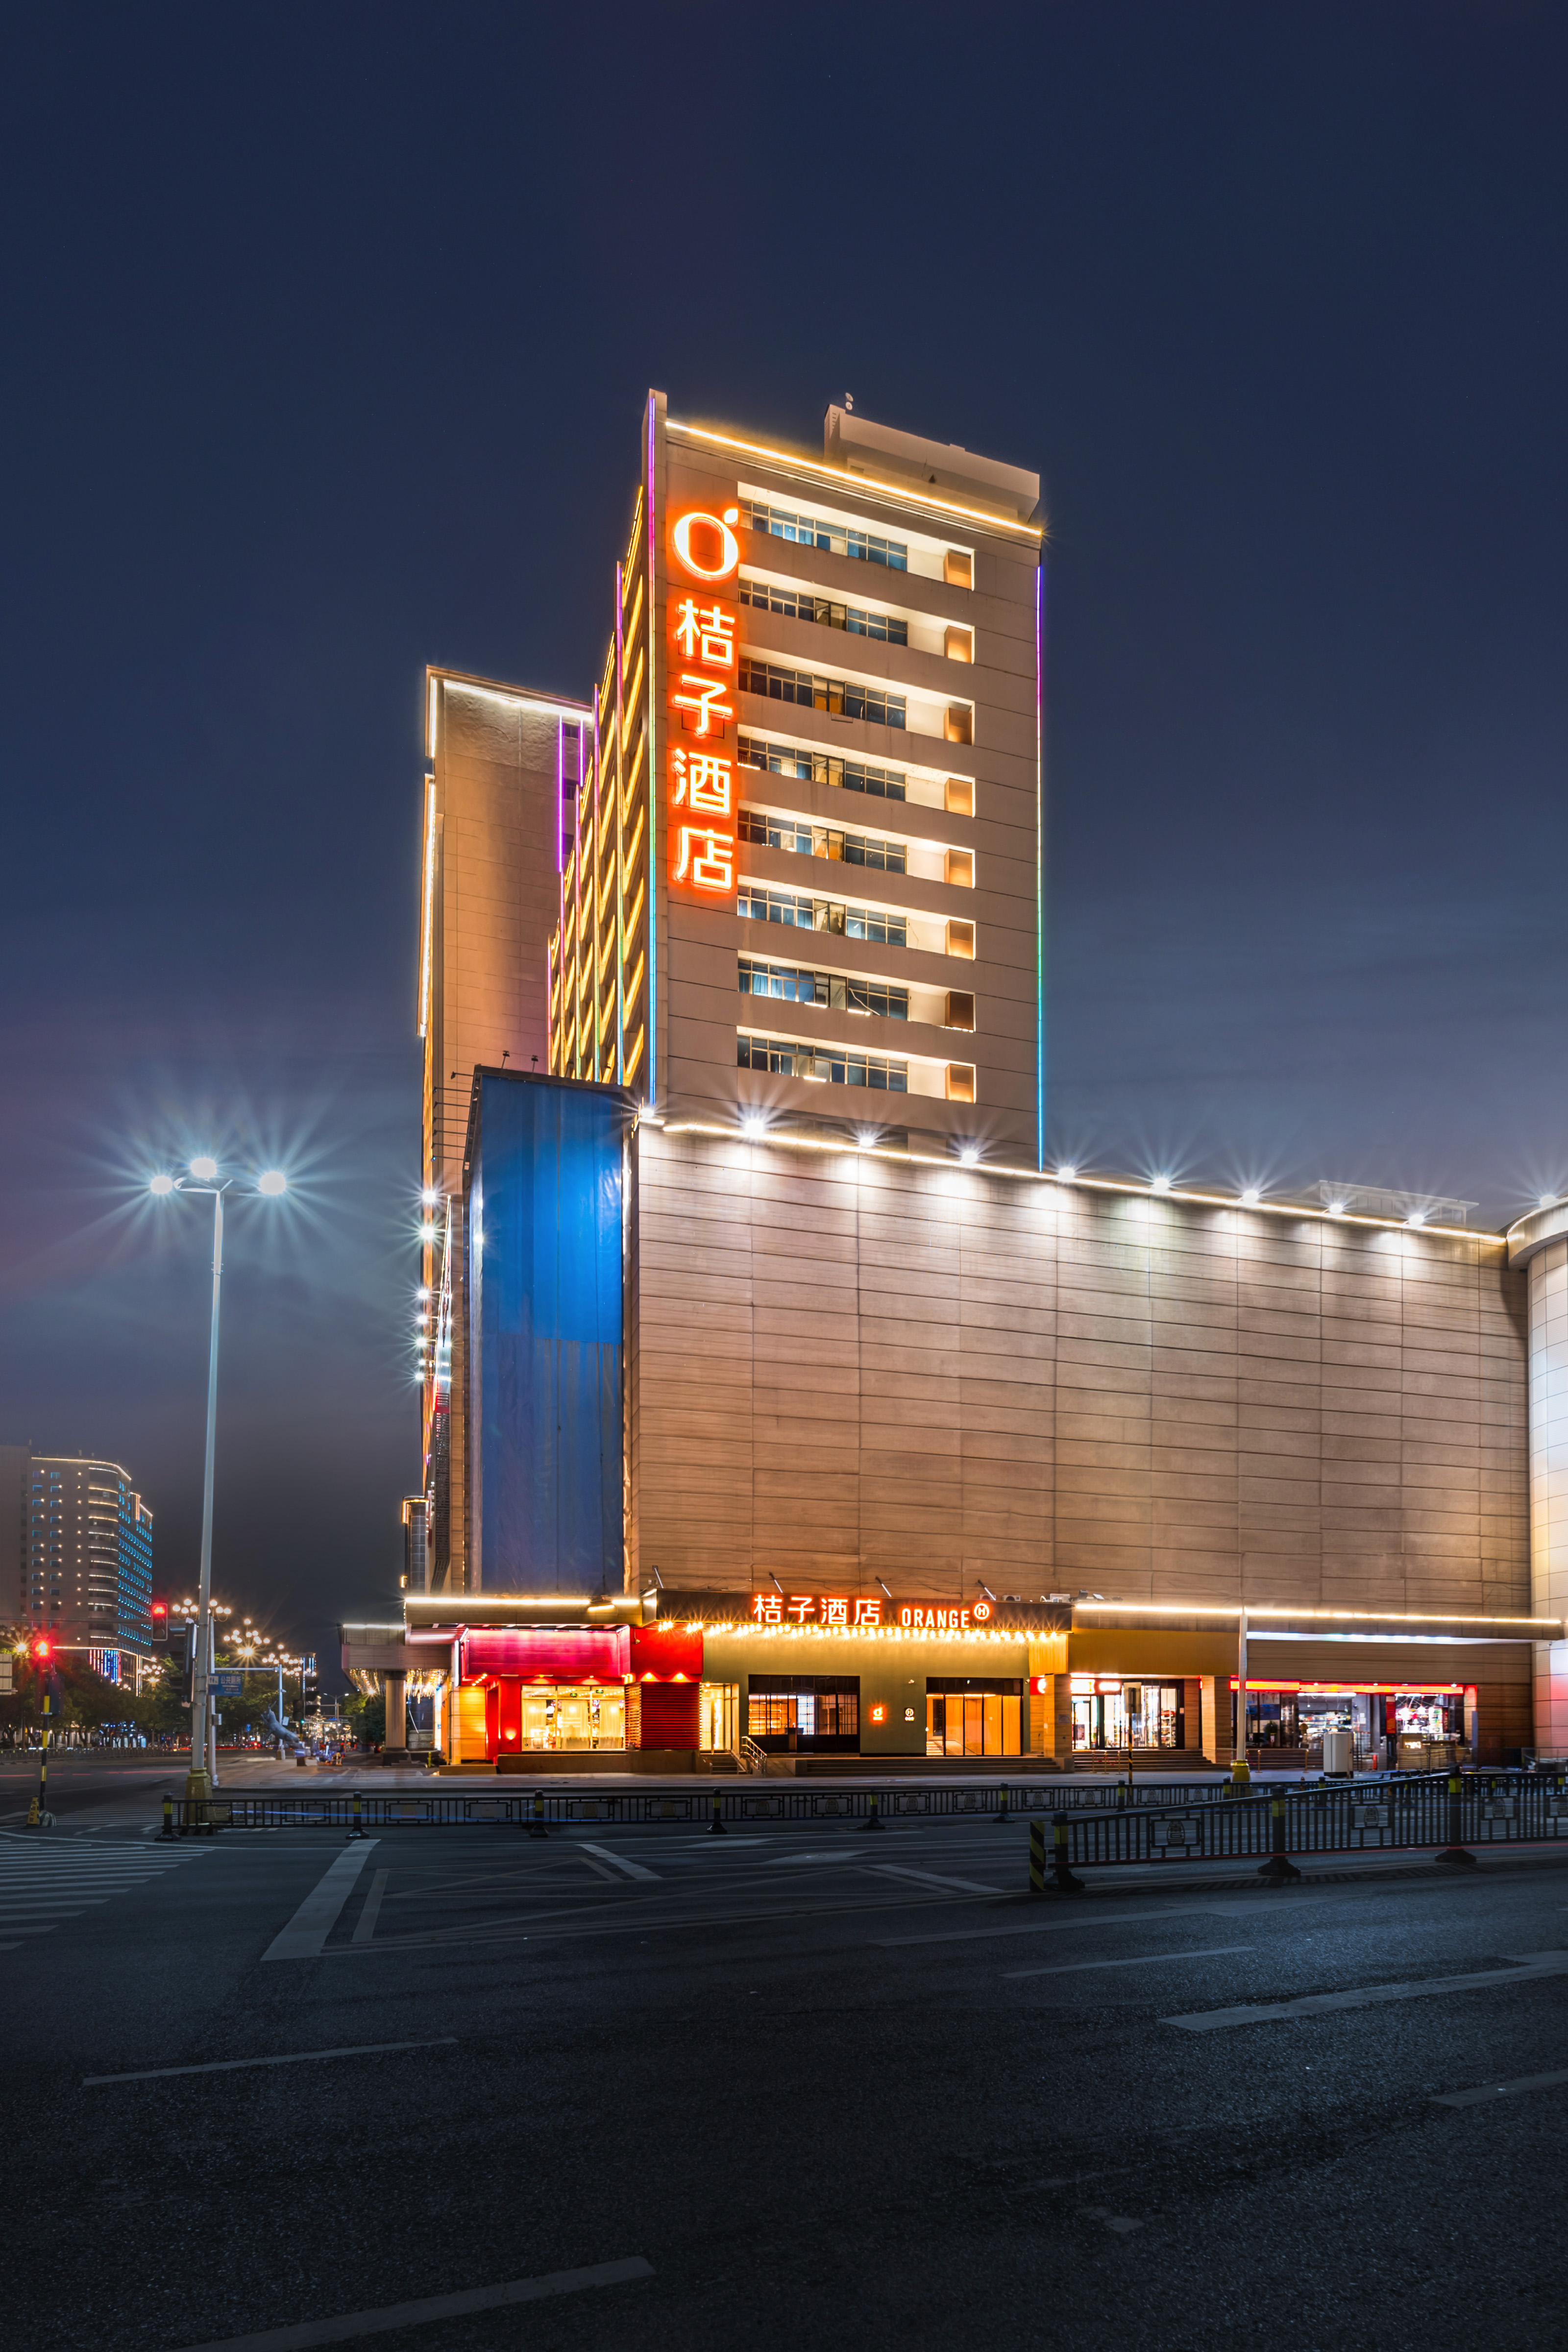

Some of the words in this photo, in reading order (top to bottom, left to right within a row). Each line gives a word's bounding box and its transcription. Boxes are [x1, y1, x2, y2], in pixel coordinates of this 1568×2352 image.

[674, 599, 735, 890] 桔子酒店
[754, 1594, 881, 1625] 桔子酒店
[902, 1608, 969, 1628] ORANGE
